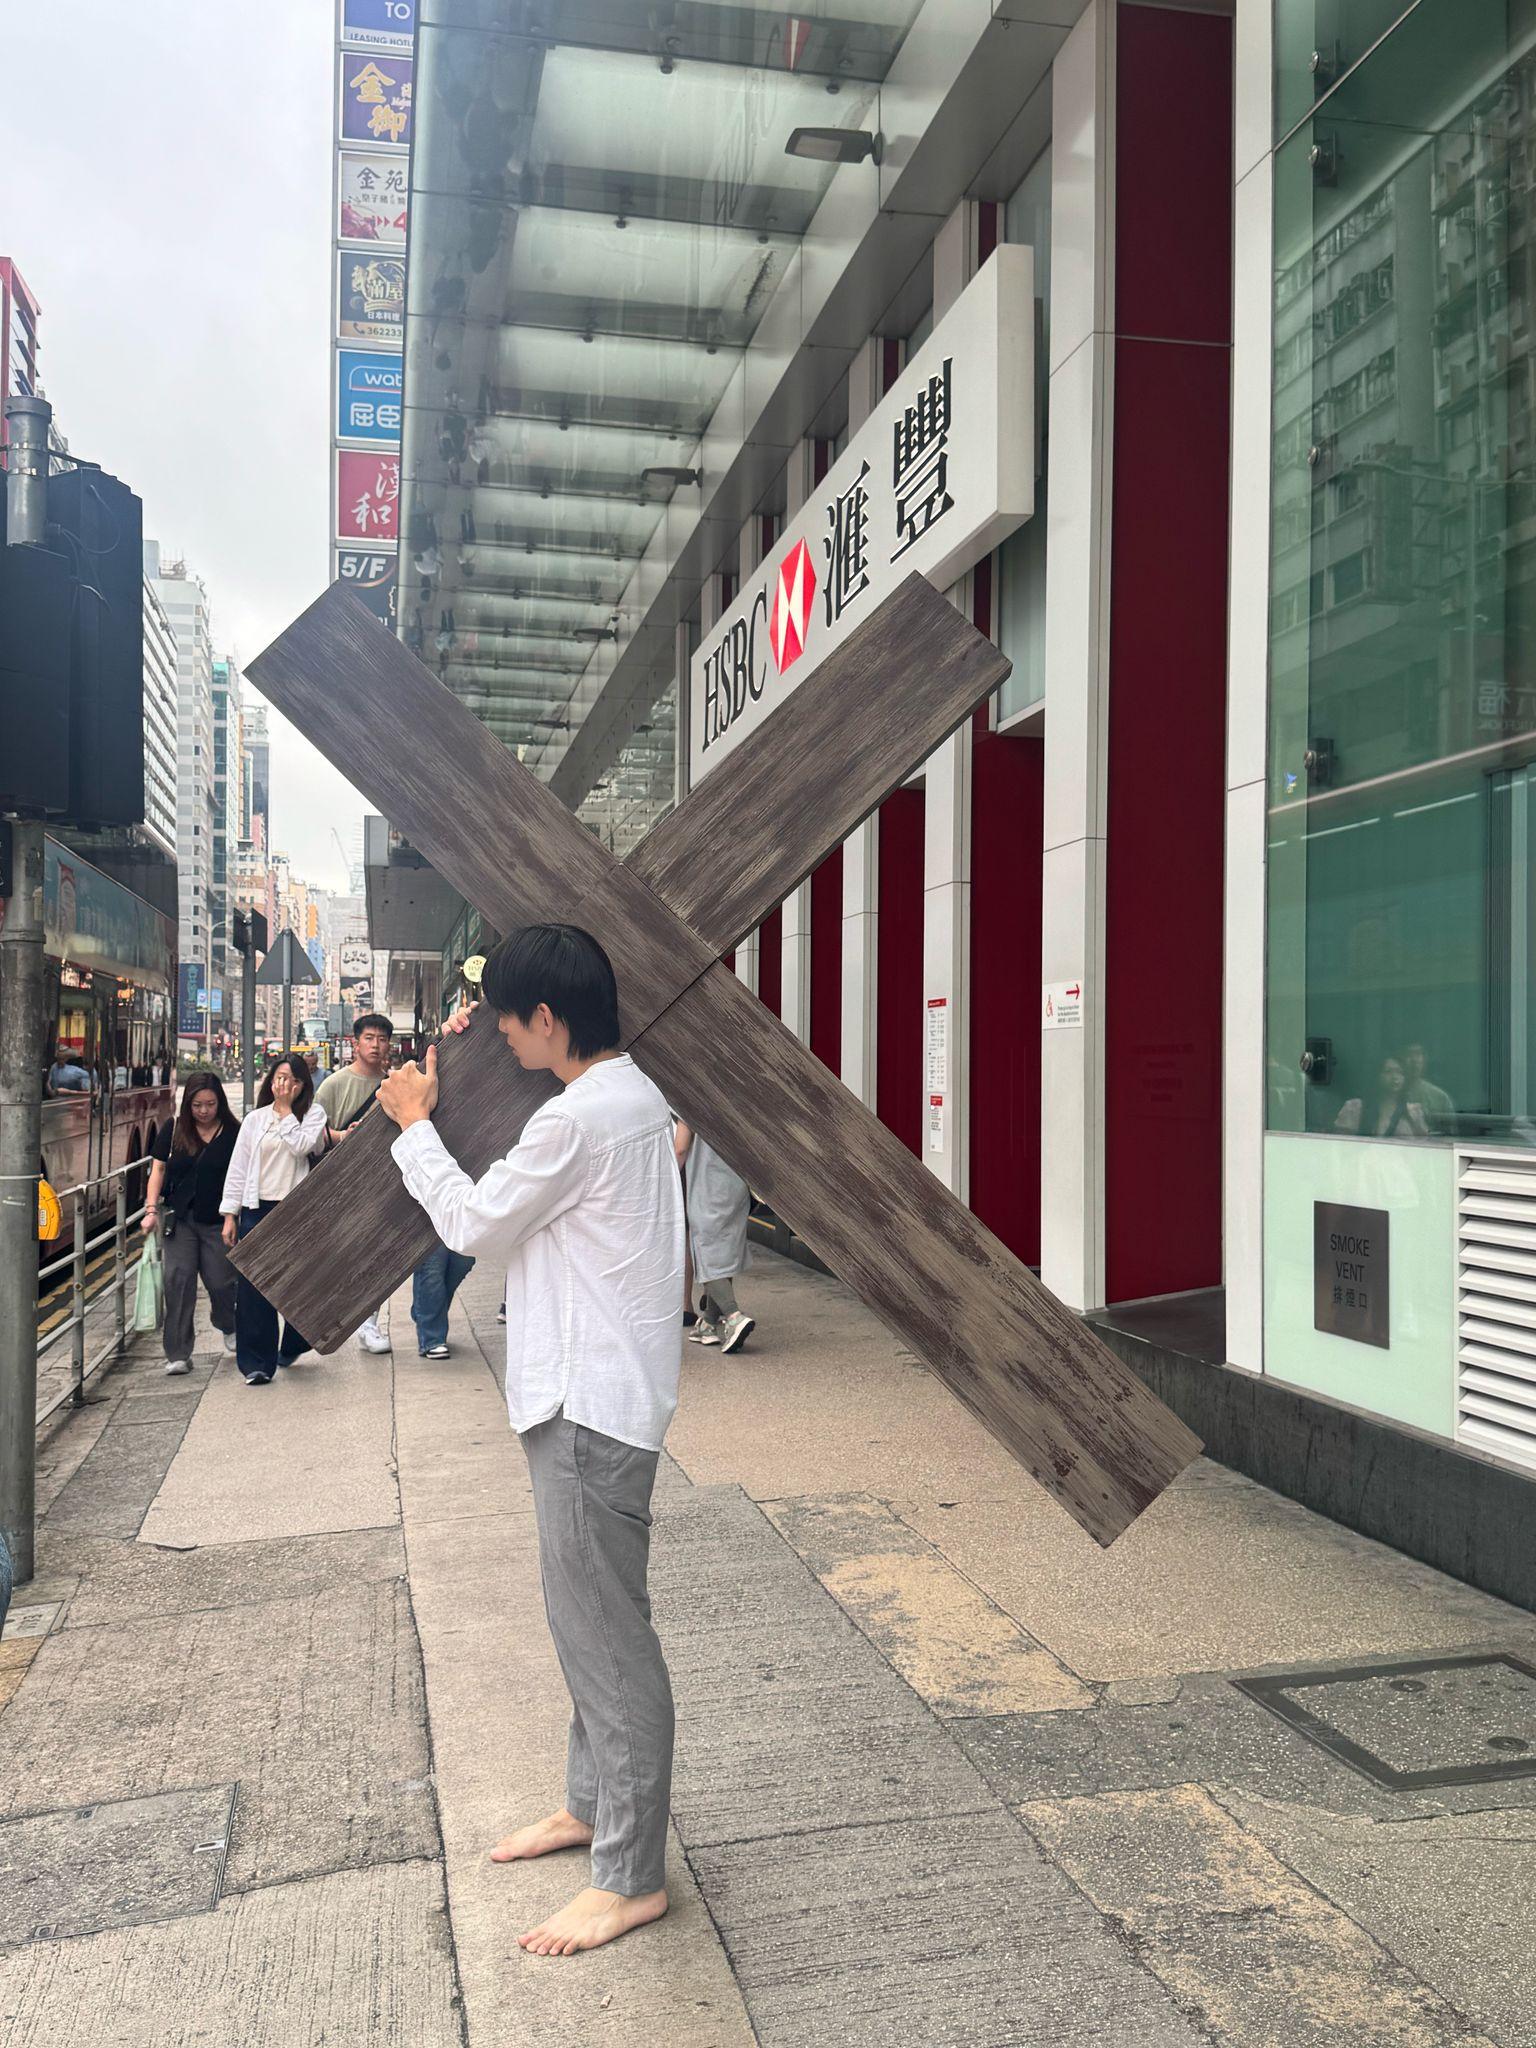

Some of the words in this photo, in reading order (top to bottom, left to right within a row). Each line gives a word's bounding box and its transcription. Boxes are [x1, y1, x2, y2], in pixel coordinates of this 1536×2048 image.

[384, 2, 411, 20] TO
[350, 32, 388, 44] LEASING
[356, 166, 407, 193] 金苑
[367, 311, 401, 321] 日本料理
[364, 371, 402, 387] wat
[350, 402, 401, 429] 屈臣
[341, 556, 387, 579] 5/F
[702, 582, 769, 753] HSBC
[1330, 1233, 1370, 1257] SMOKE
[1335, 1260, 1365, 1282] VENT
